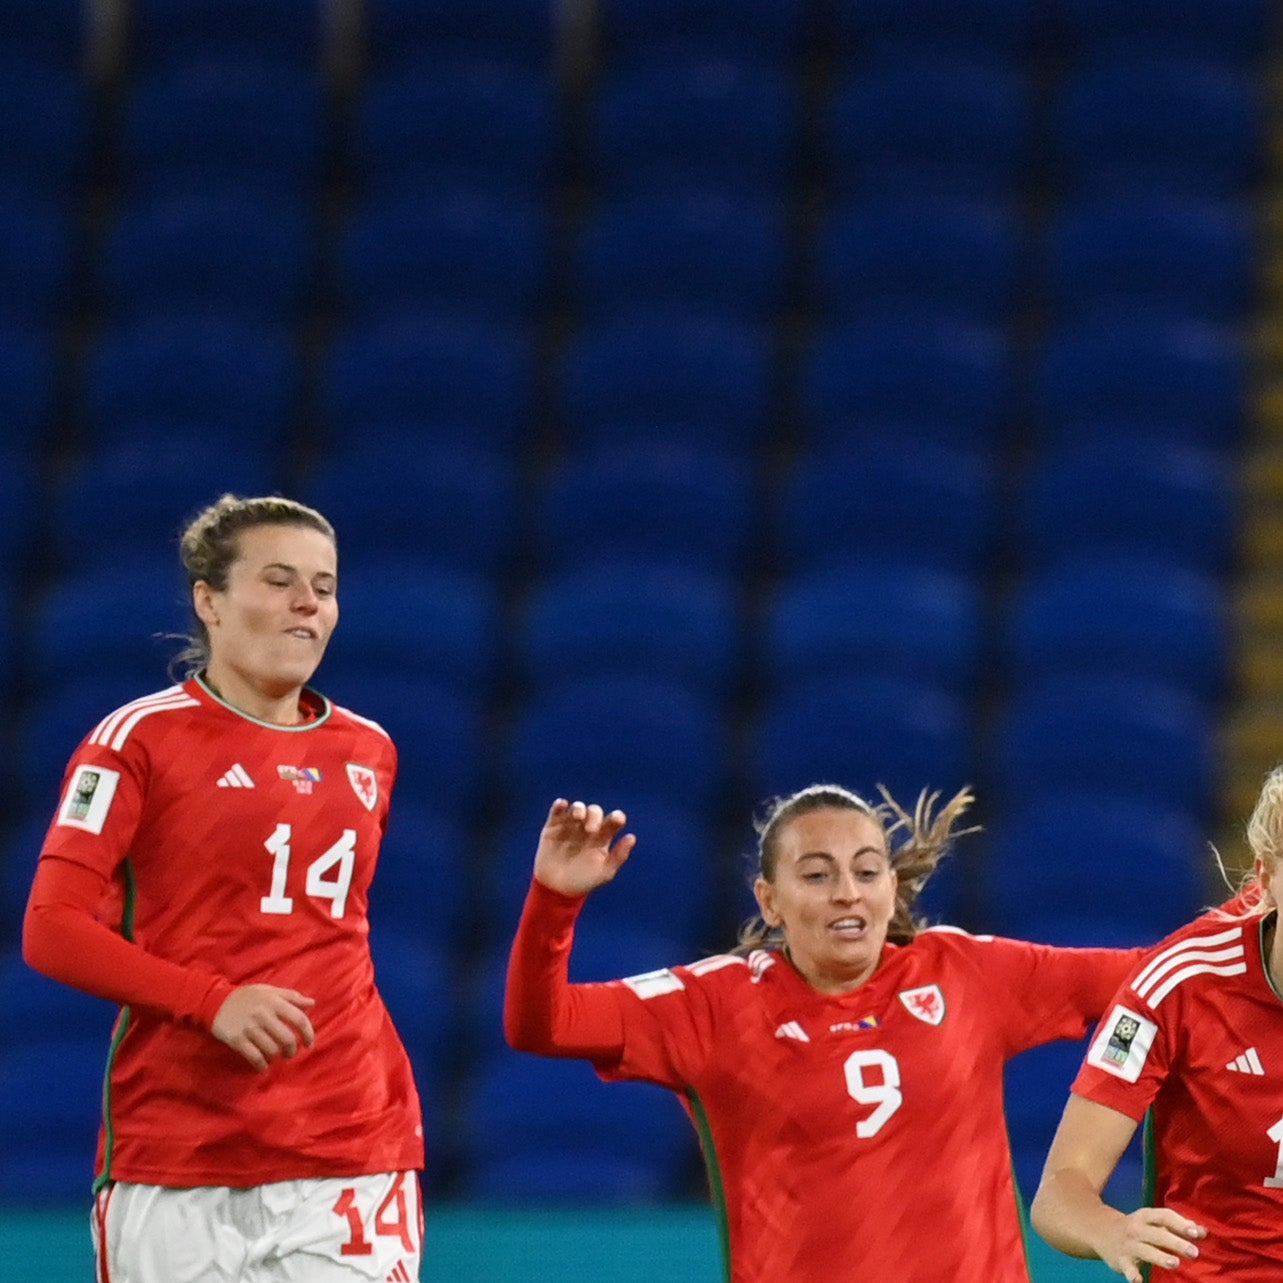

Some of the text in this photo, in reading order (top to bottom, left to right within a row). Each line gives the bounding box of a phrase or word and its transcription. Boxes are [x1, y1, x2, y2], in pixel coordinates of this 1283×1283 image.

[260, 823, 357, 919] 14
[843, 1048, 903, 1139] 9
[332, 1170, 417, 1256] 14
